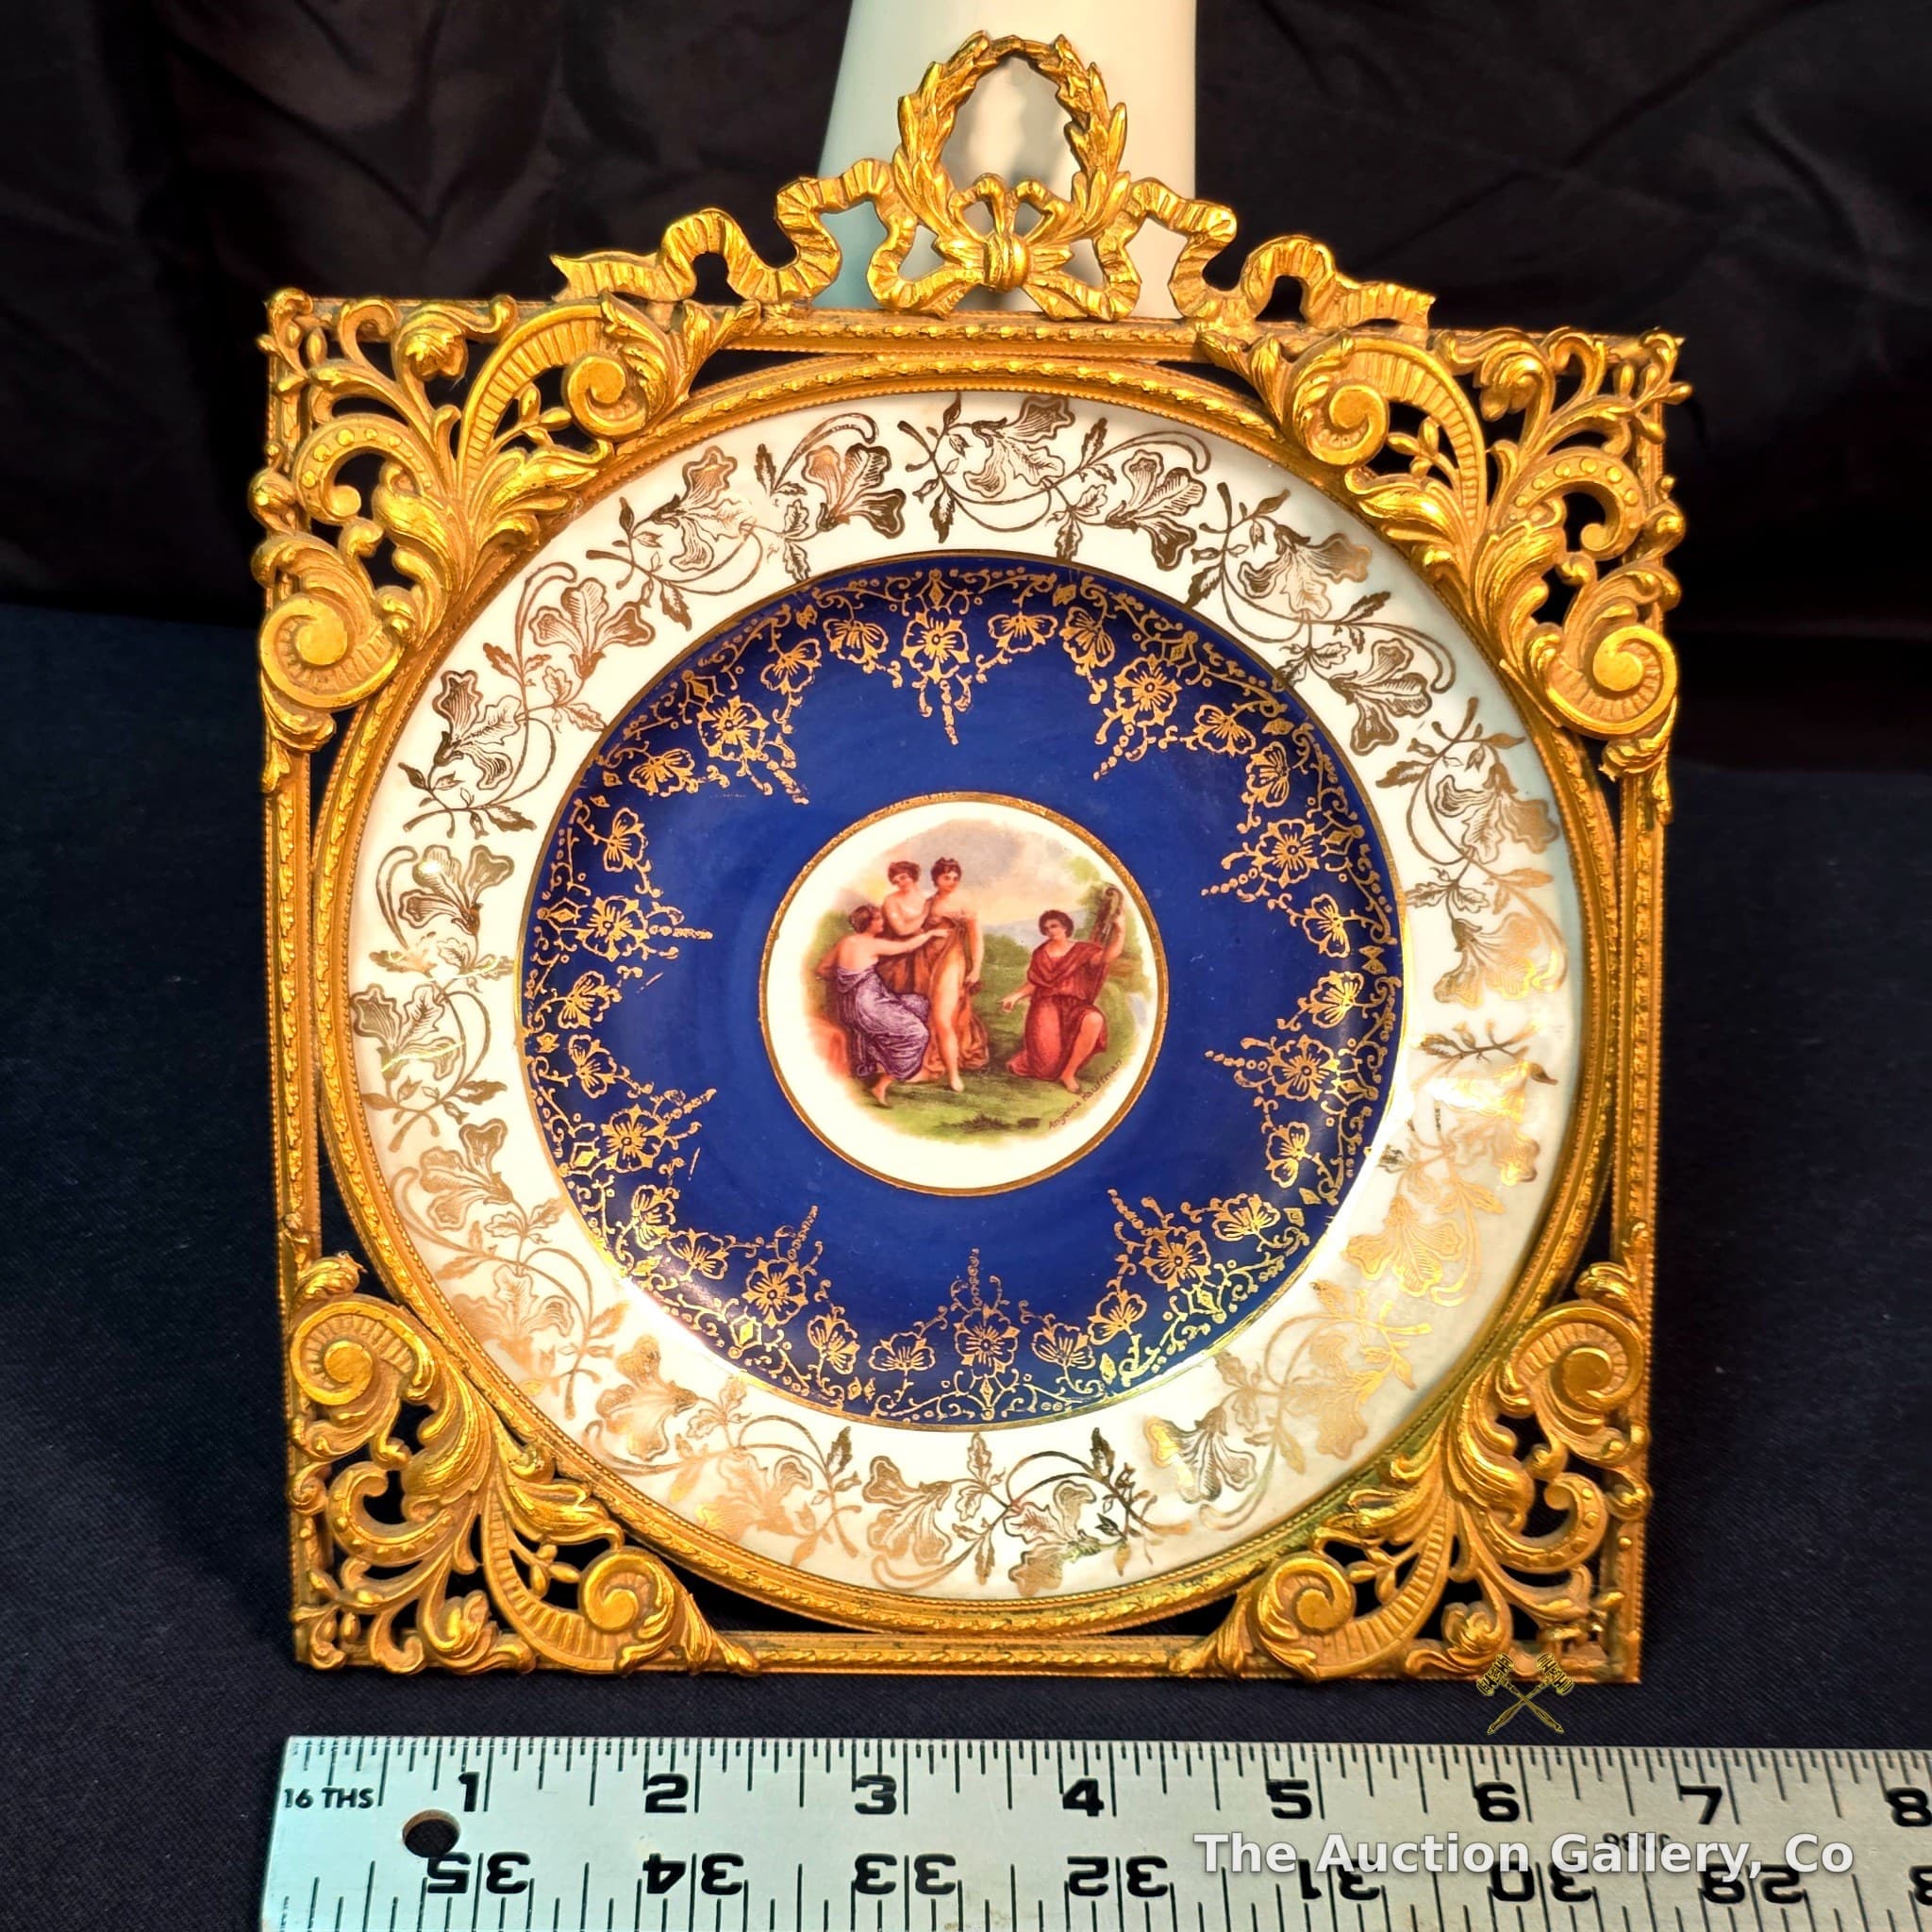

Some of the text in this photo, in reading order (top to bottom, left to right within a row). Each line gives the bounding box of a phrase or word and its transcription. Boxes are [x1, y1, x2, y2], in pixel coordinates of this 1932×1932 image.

[284, 1788, 375, 1809] 16 THS
[458, 1772, 1932, 1827] 1 2 3 4 5 6 7 8
